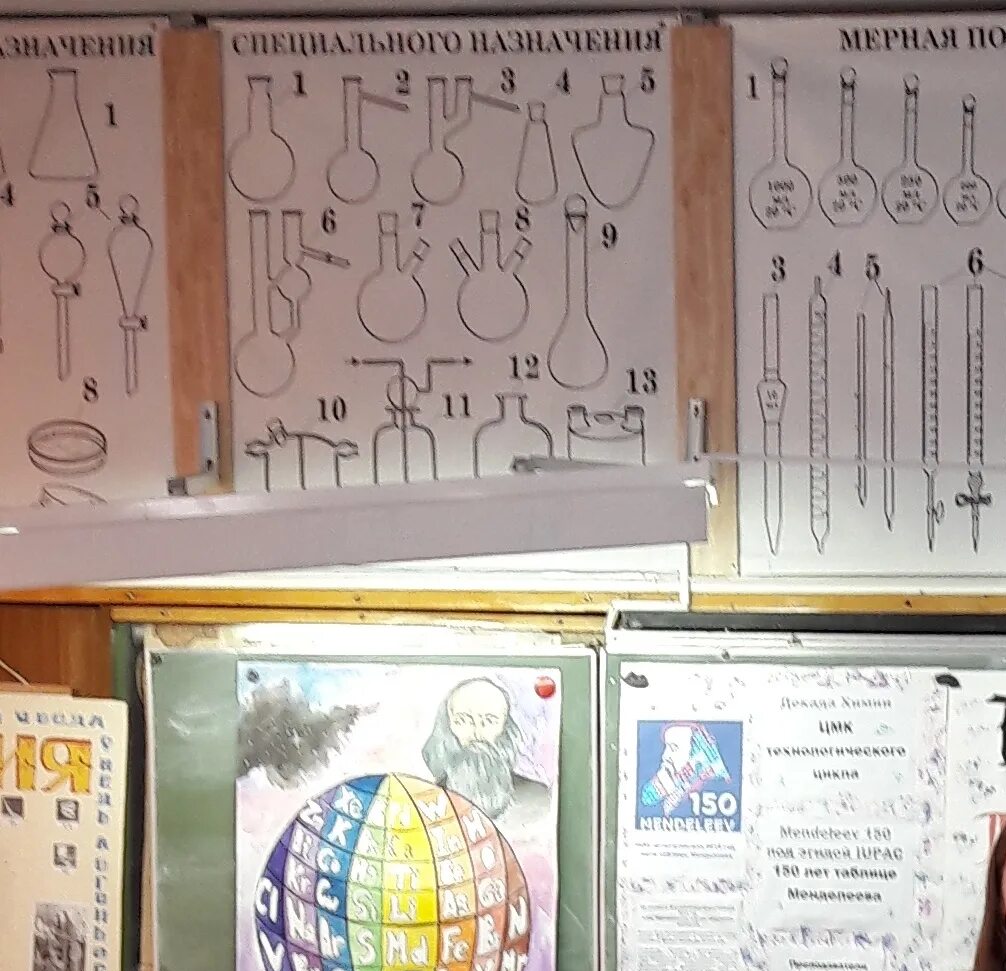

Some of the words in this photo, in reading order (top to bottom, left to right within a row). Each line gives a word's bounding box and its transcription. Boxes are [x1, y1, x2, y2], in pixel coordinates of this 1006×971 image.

[232, 30, 461, 55] СПЕЦИАЛЬНОГО
[839, 26, 957, 50] МЕРНАЯ
[293, 71, 307, 96] 1
[396, 69, 410, 95] 2
[501, 67, 515, 94] 3
[556, 67, 570, 94] 4
[641, 66, 655, 94] 5
[746, 75, 759, 100] 1
[104, 102, 118, 127] 1
[87, 184, 100, 208] 5
[321, 207, 337, 235] 6
[412, 202, 425, 228] 7
[515, 205, 530, 232] 8
[602, 222, 618, 249] 9
[771, 255, 786, 283] 3
[829, 249, 842, 276] 4
[866, 253, 881, 281] 5
[968, 247, 984, 275] 6
[509, 354, 539, 380] 12
[82, 376, 99, 403] 8
[625, 368, 657, 395] 13
[318, 397, 347, 423] 10
[442, 393, 470, 419] 11
[841, 696, 892, 709] Химии
[818, 720, 854, 736] ЦМК
[766, 745, 907, 758] технологического
[813, 768, 860, 782] цикла
[689, 792, 738, 816] 150
[640, 816, 736, 833] MENDELEEV
[780, 825, 858, 841] Mendeleev
[866, 826, 892, 842] 150
[767, 846, 795, 860] под
[856, 845, 904, 861] IUPAC
[774, 864, 801, 879] 150
[804, 867, 830, 880] лет
[834, 865, 898, 882] таблице
[787, 887, 883, 903] Менделеева
